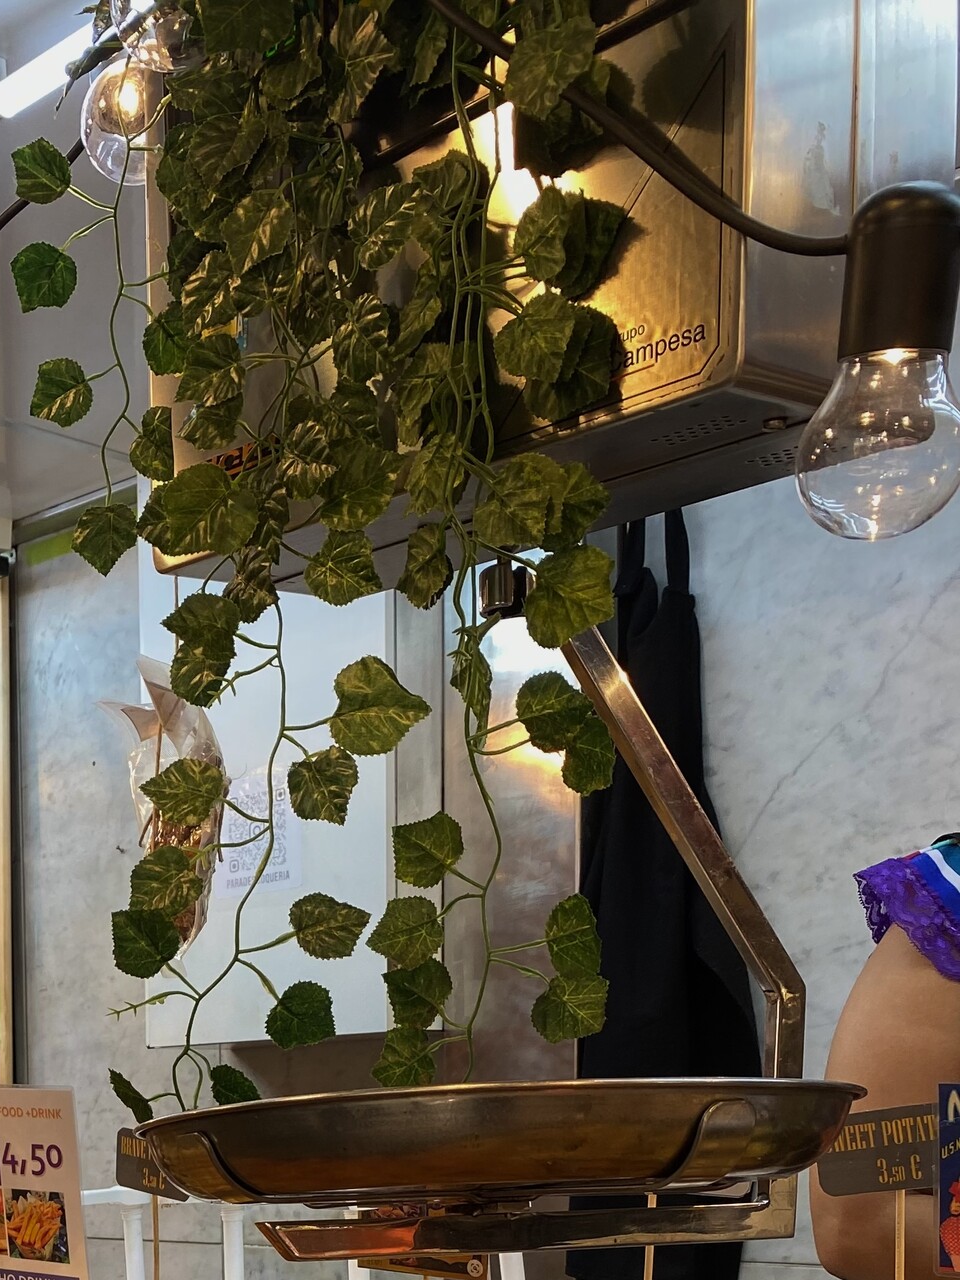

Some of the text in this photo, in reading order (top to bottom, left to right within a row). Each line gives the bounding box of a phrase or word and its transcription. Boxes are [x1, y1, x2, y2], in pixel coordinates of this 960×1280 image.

[619, 324, 646, 343] rupo
[121, 1135, 147, 1160] BRAVE
[828, 1114, 937, 1153] WEET POTAT
[2, 1142, 63, 1176] 4,50
[876, 1153, 923, 1185] 3,50 €
